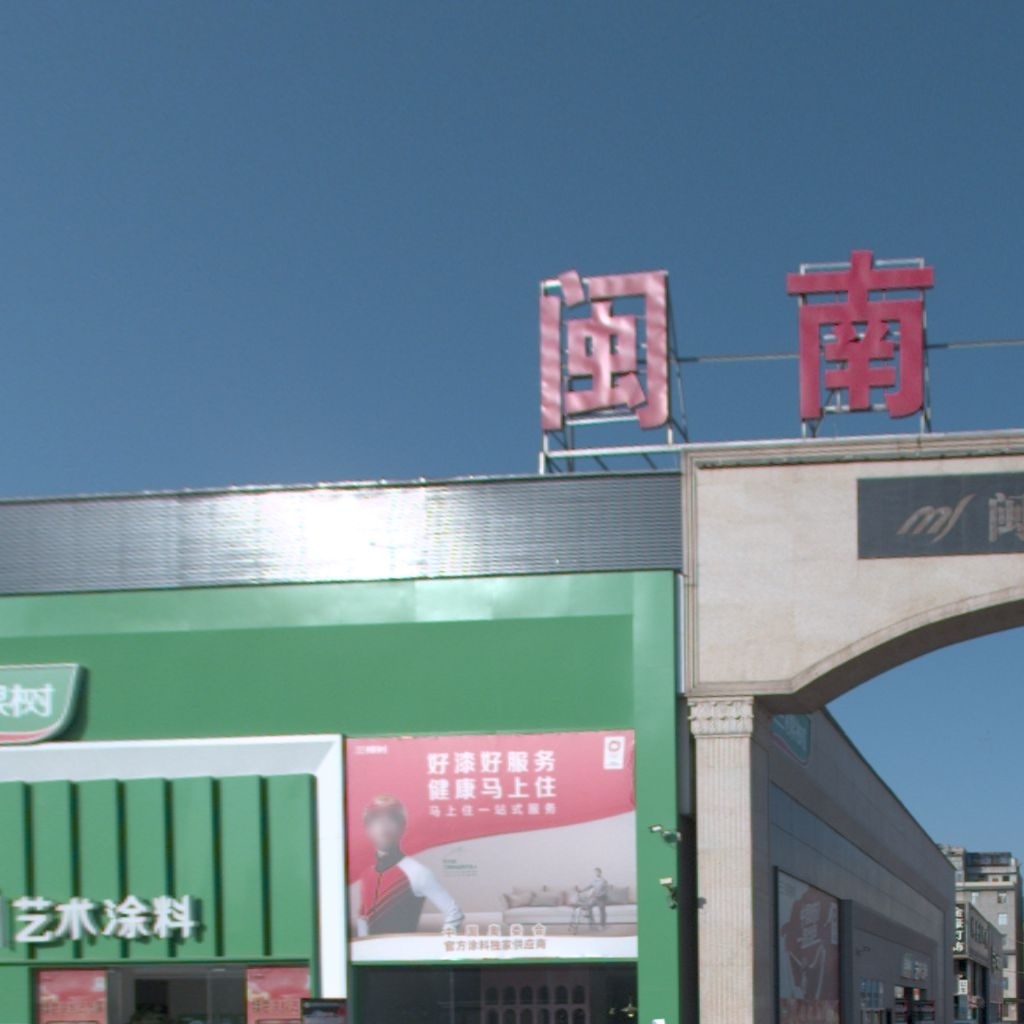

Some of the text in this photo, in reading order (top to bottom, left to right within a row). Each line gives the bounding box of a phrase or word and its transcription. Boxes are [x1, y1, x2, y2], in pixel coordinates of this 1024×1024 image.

[427, 751, 556, 775] 好漆好服务
[428, 776, 557, 801] 健康马上住
[428, 802, 556, 818] 马上住一站式服务
[12, 894, 195, 942] 艺术涂料
